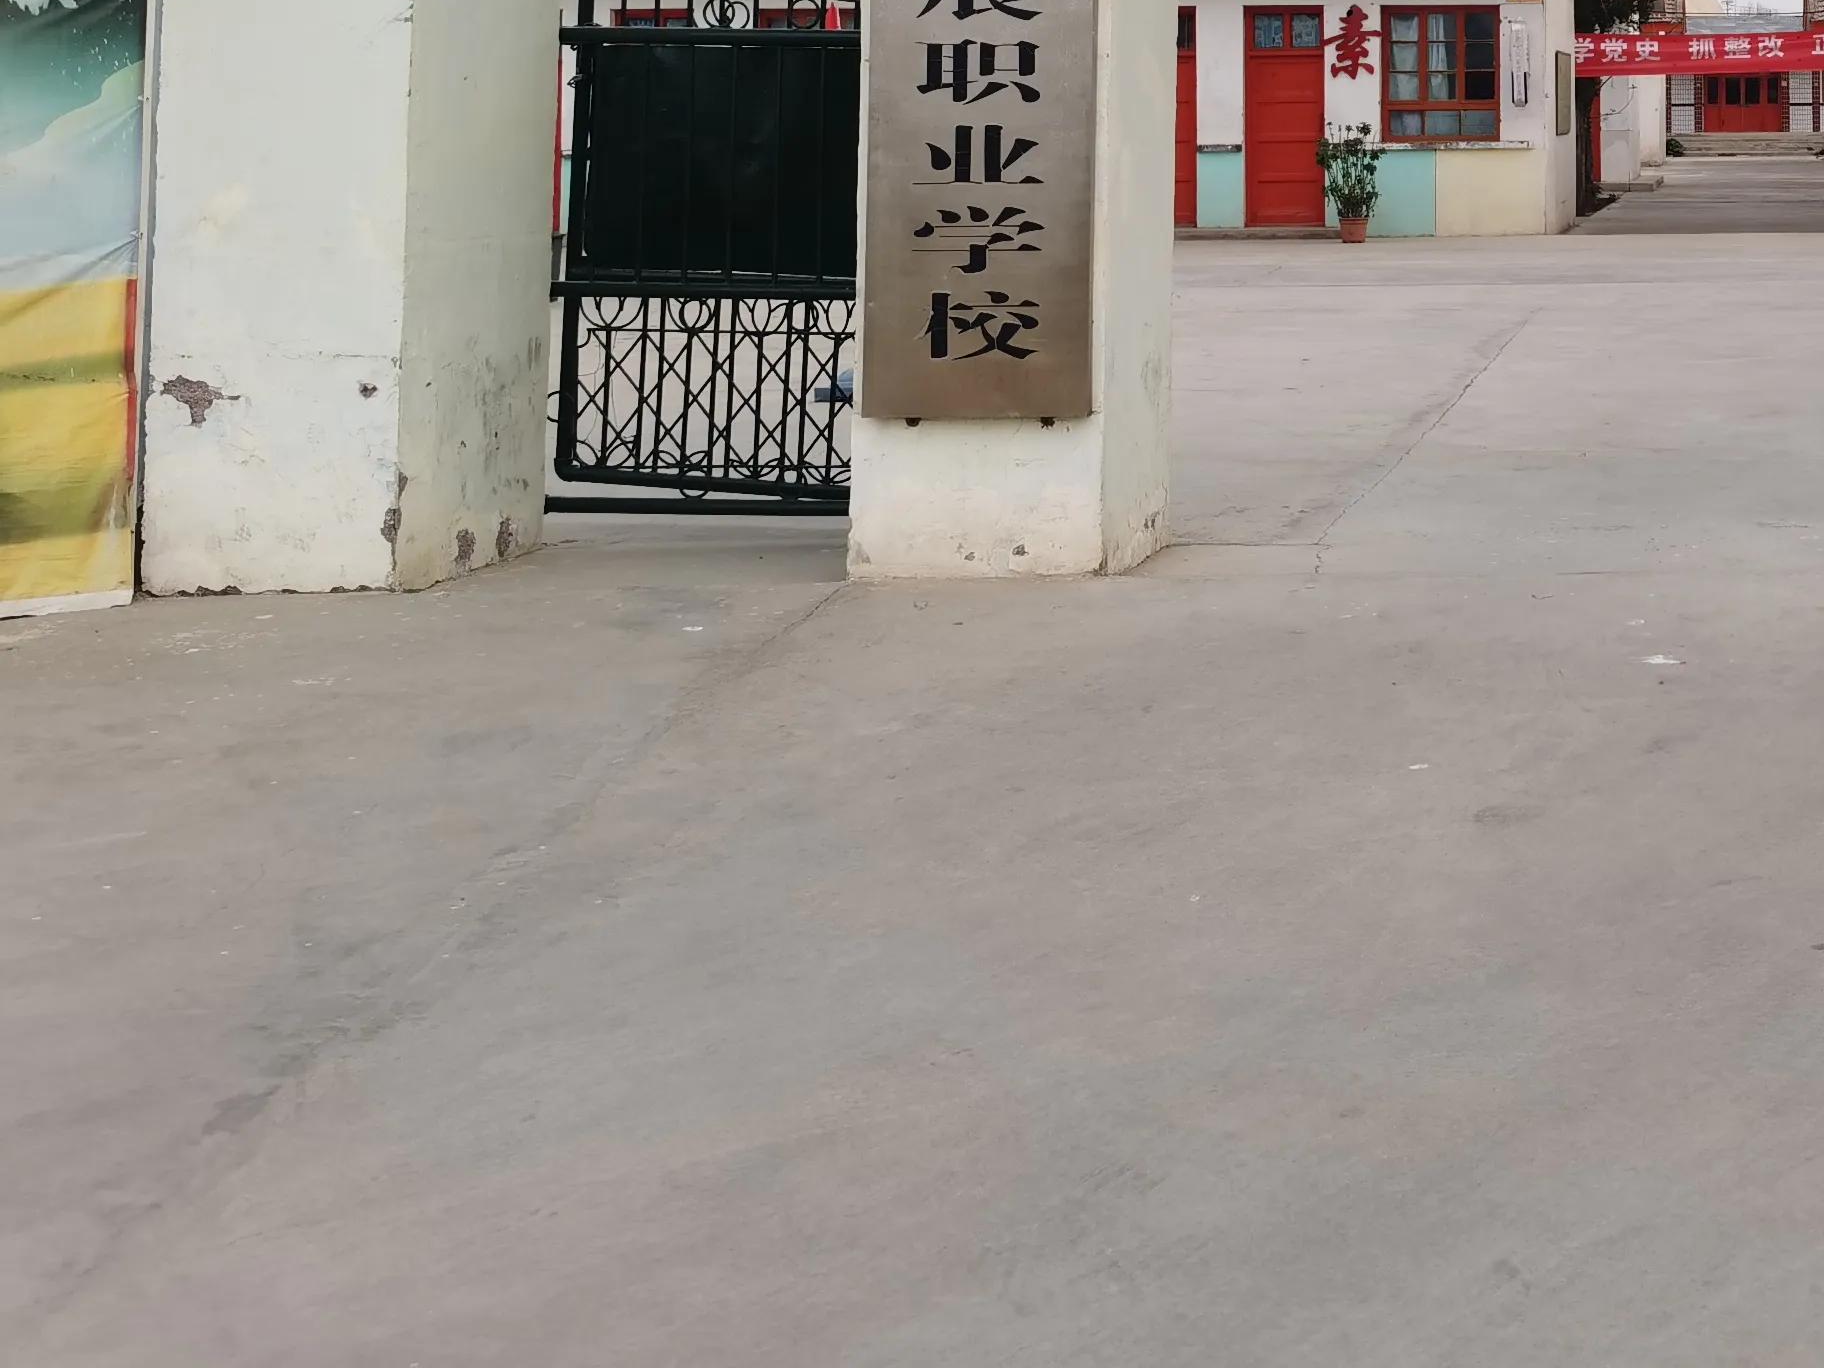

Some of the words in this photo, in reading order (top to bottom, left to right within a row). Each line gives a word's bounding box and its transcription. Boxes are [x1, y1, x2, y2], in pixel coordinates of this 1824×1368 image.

[1321, 3, 1383, 80] 素
[1575, 36, 1661, 64] 学党史
[1688, 36, 1785, 61] 抓整改
